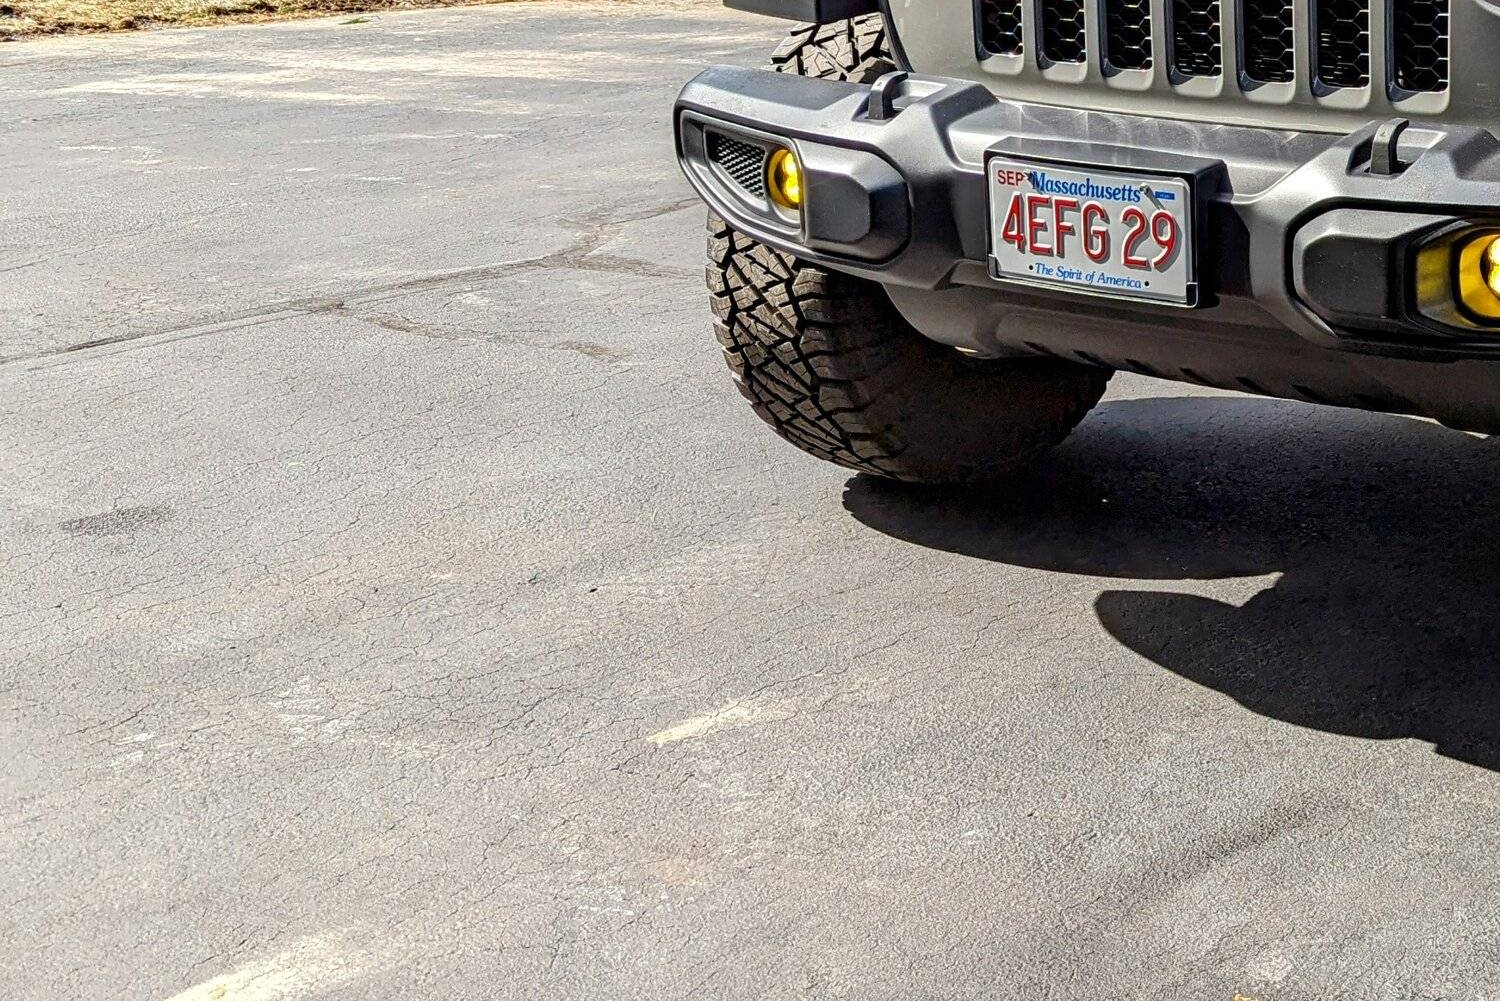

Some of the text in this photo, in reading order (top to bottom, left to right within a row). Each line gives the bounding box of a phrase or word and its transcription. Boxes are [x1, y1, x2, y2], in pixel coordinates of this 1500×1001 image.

[997, 169, 1024, 187] SEP
[1031, 171, 1142, 203] Massachusetts
[1001, 191, 1180, 271] 4EFG 29
[1034, 262, 1142, 289] The Spirit of America
